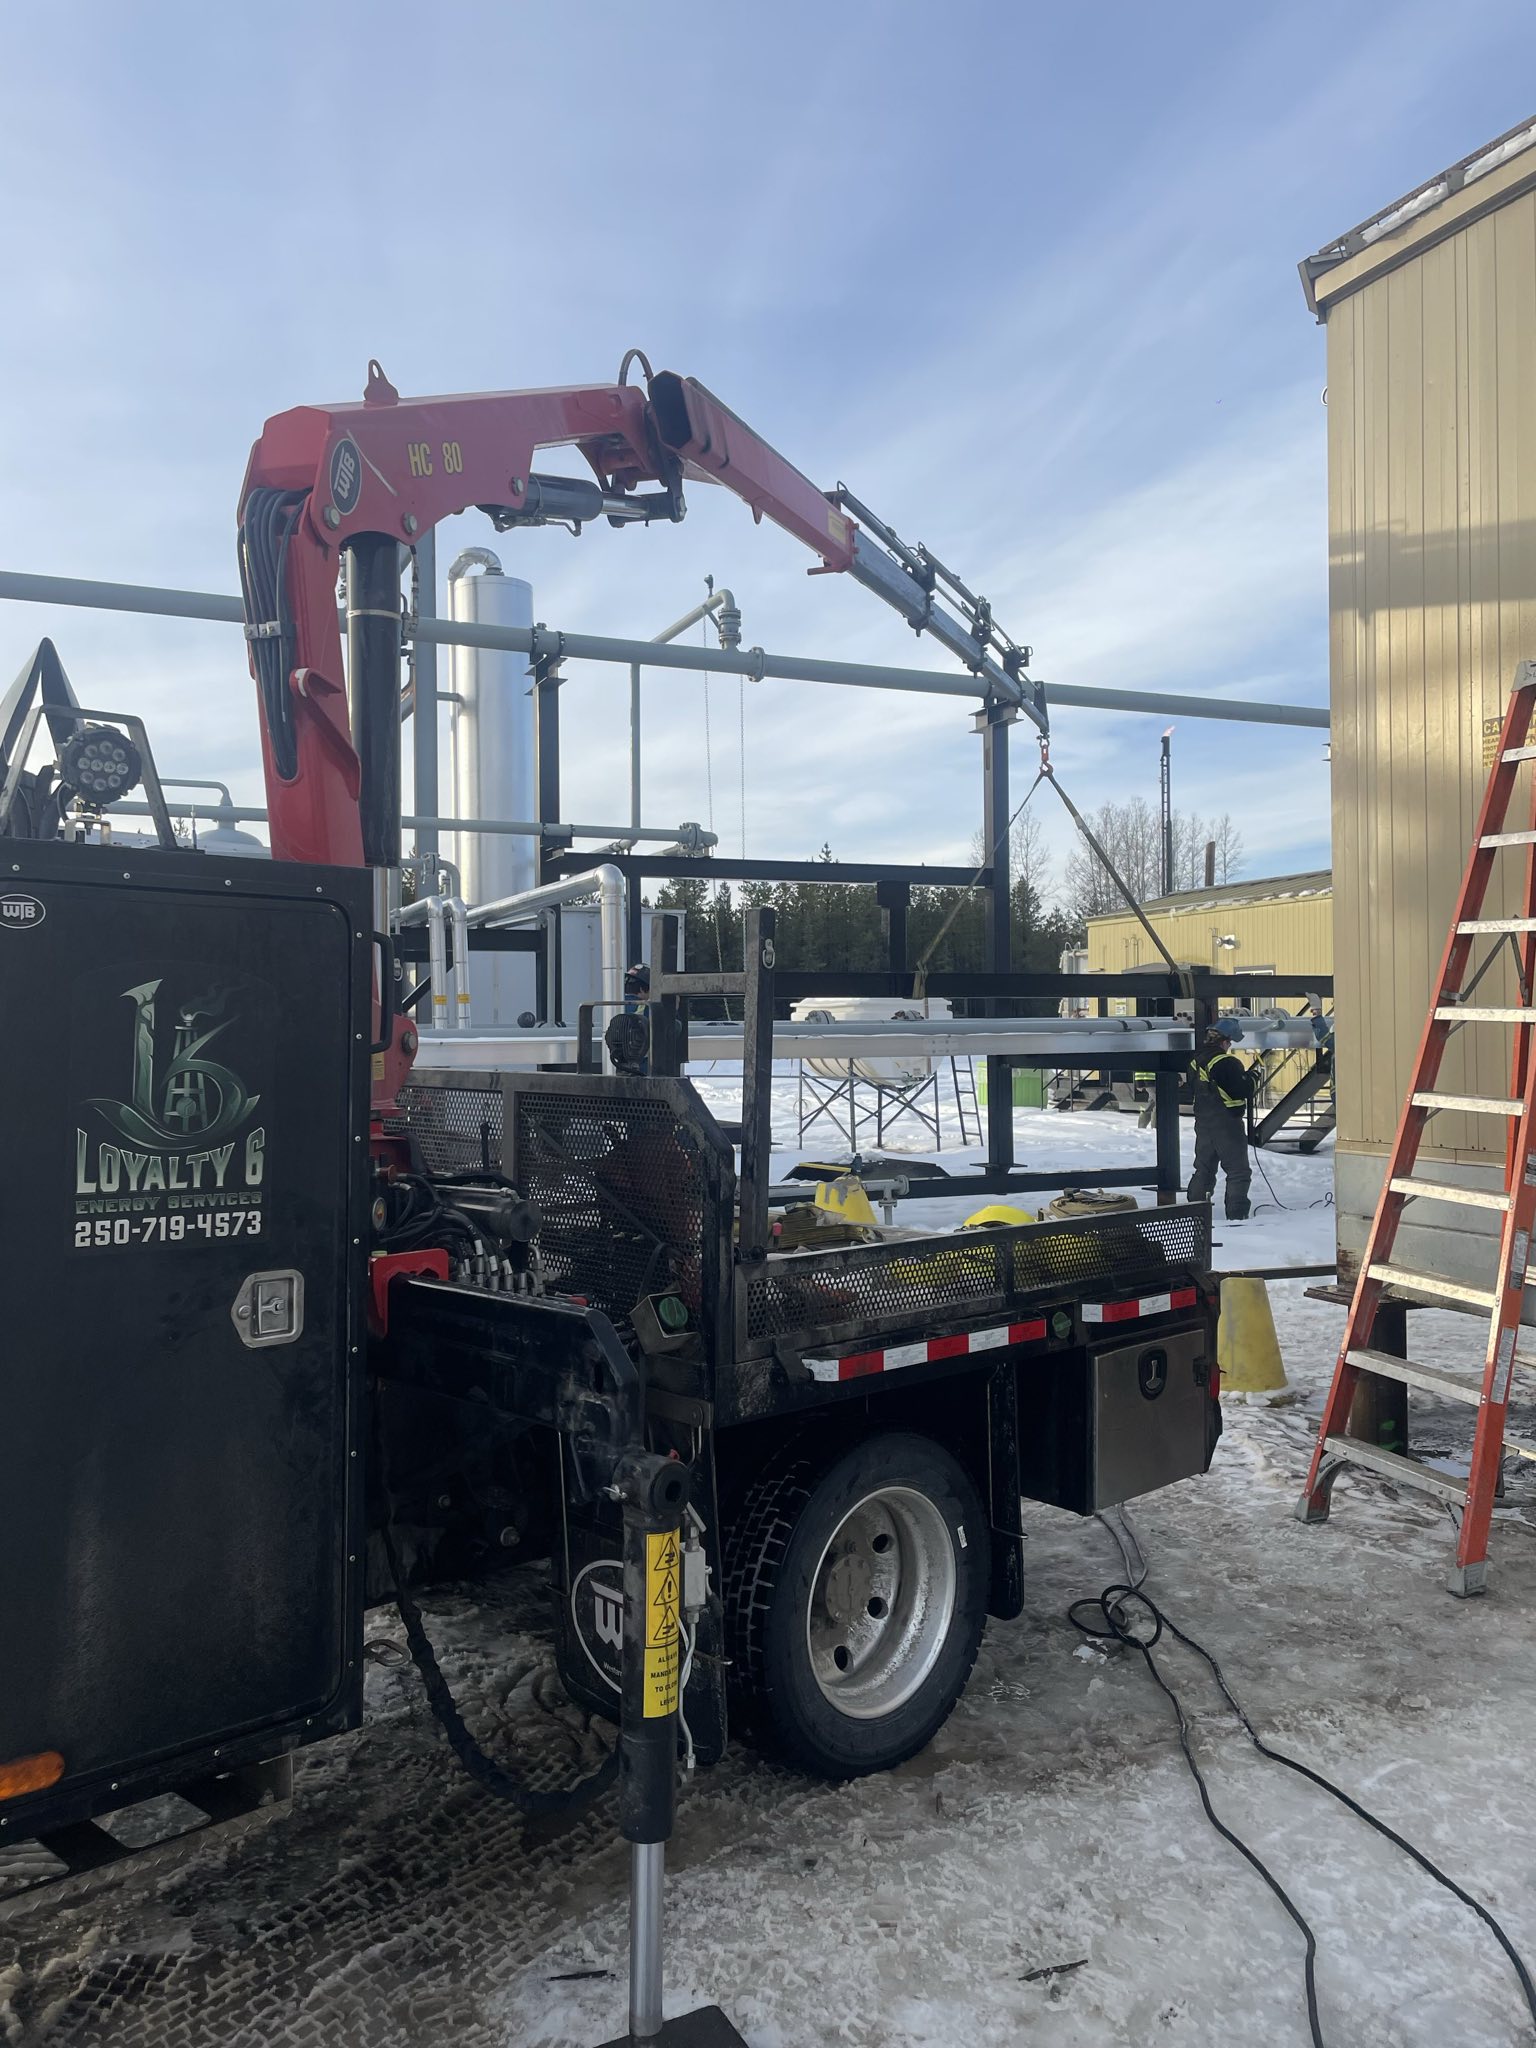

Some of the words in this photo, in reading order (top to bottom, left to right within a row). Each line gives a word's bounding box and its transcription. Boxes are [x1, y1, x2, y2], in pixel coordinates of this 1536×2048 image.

[407, 443, 433, 477] HC
[442, 442, 463, 474] 80
[75, 1127, 236, 1194] LOYALTY
[244, 1126, 266, 1187] 6
[75, 1197, 161, 1215] ENERGY
[167, 1191, 263, 1209] SERVICES
[74, 1211, 262, 1248] 250-719-4573
